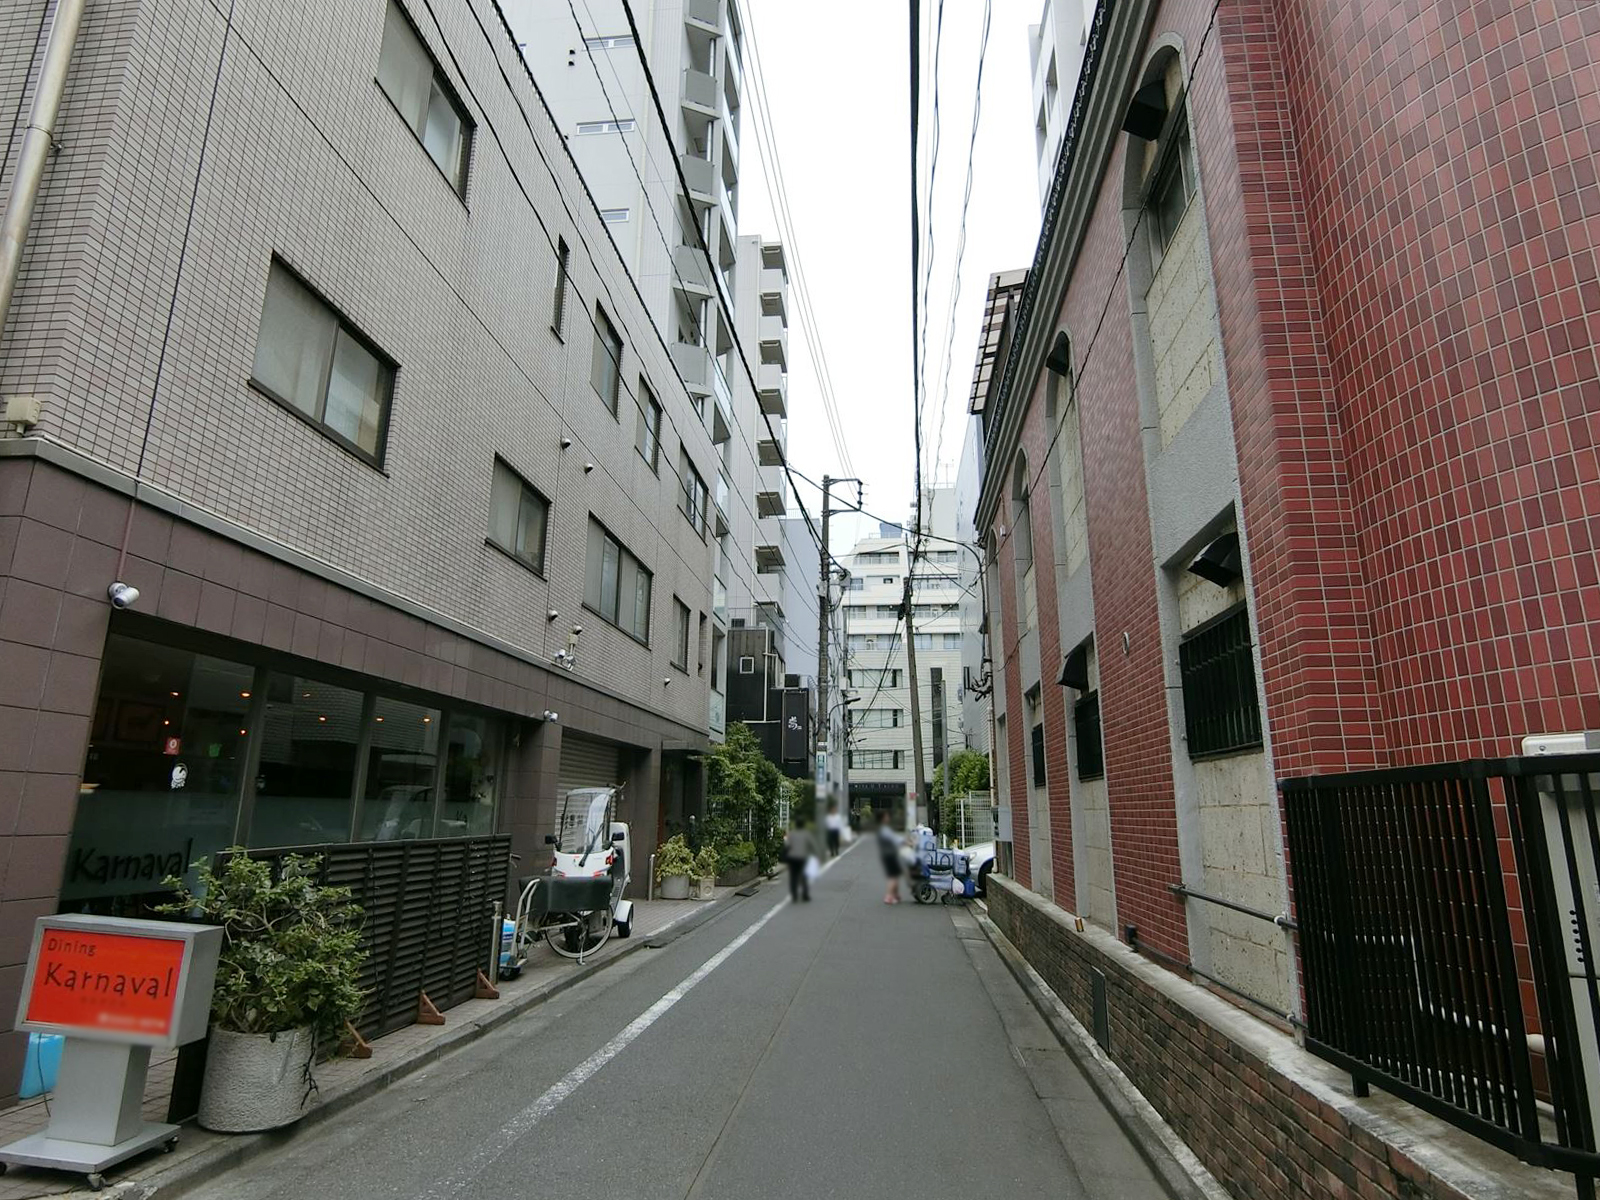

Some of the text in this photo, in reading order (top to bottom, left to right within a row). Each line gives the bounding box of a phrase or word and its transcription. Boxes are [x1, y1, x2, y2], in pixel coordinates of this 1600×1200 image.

[71, 837, 193, 884] Karnaval
[47, 938, 96, 957] Dining
[44, 962, 174, 999] Karnaval
